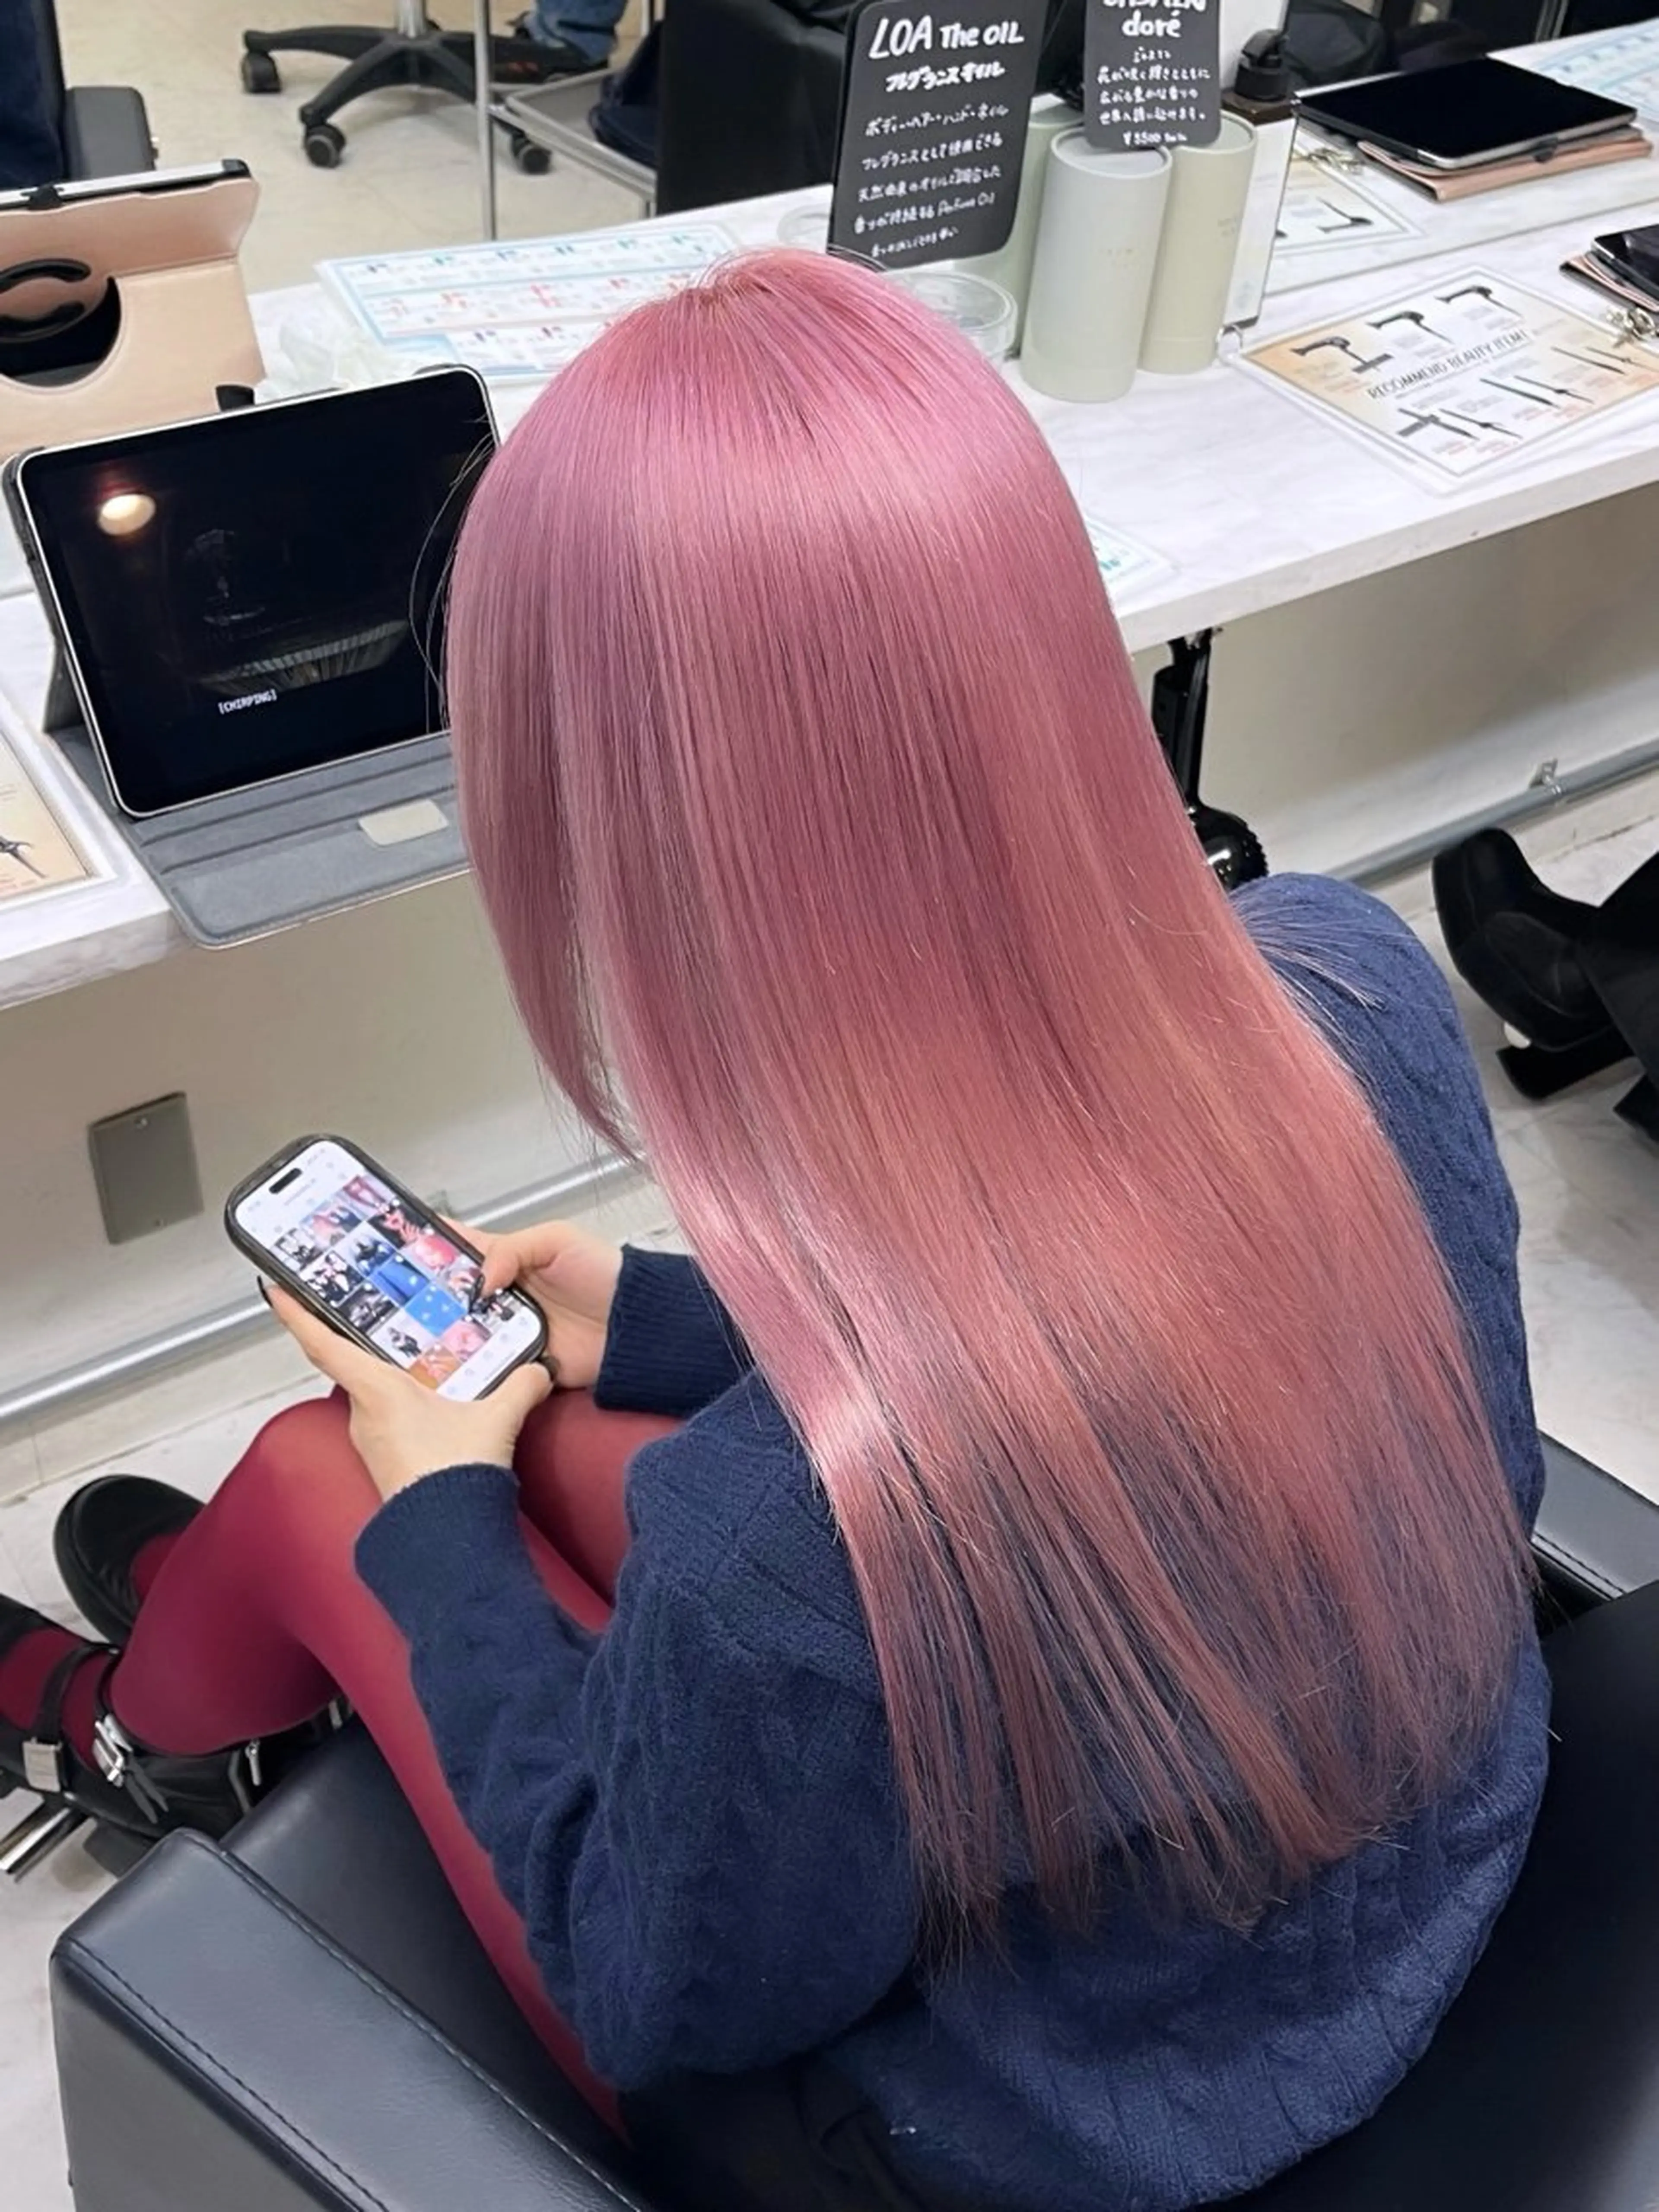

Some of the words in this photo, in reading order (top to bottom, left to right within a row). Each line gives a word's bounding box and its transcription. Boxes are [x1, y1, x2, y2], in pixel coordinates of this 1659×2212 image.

[869, 14, 932, 59] LOA
[939, 22, 979, 49] The
[1122, 9, 1181, 38] doré
[1367, 362, 1448, 400] RECOMMEND
[1446, 343, 1494, 370] BEAUTY
